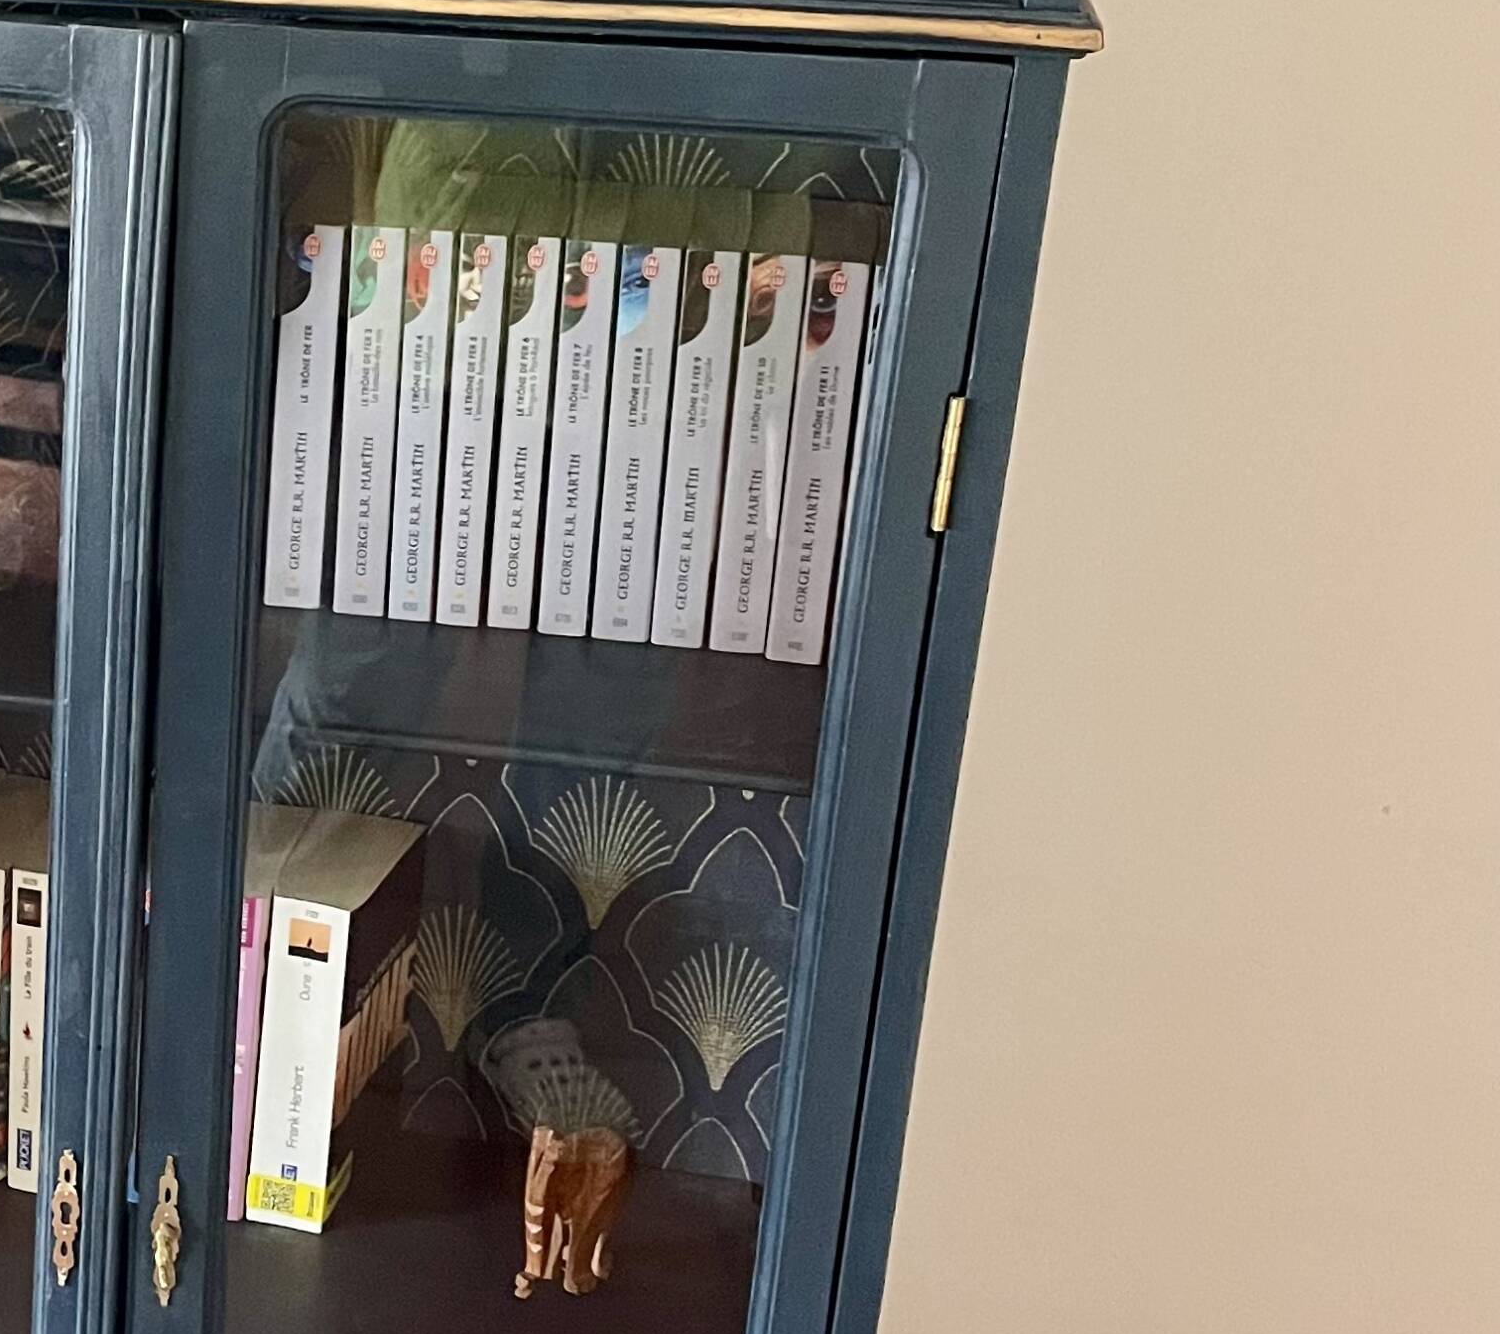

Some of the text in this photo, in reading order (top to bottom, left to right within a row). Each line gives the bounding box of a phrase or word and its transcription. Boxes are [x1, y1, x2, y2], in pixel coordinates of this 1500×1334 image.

[299, 325, 313, 403] LE TRÔNE DE FER
[519, 363, 528, 373] DE
[520, 345, 529, 359] FER
[820, 366, 830, 374] 11
[816, 394, 826, 406] DE
[818, 377, 828, 392] FER
[516, 408, 524, 416] LE
[293, 432, 308, 484] MARTIN
[360, 436, 374, 490] MARTIN
[411, 443, 424, 498] MARTIN
[460, 445, 474, 499] MARTIN
[513, 446, 527, 500] MARTIN
[811, 442, 820, 451] LE
[566, 454, 580, 508] MARTIN
[624, 457, 639, 512] MARTIN
[289, 517, 302, 570] GEORGE
[355, 523, 369, 576] GEORGE
[406, 530, 419, 584] GEORGE
[454, 533, 468, 586] GEORGE
[506, 533, 521, 587] GEORGE
[675, 556, 690, 610] GEORGE
[683, 467, 699, 522] MARTIN
[737, 558, 753, 613] GEORGE
[746, 469, 762, 525] MARTIN
[793, 568, 810, 622] GEORGE
[803, 478, 821, 533] MARTIN
[559, 541, 574, 595] GEORGE
[617, 546, 632, 599] GEORGE
[24, 935, 33, 998] La Fille du train
[21, 1056, 30, 1112] Paula Hawkins
[288, 1065, 305, 1112] Herbert
[16, 1128, 32, 1169] POCKET
[285, 1117, 300, 1148] Frank
